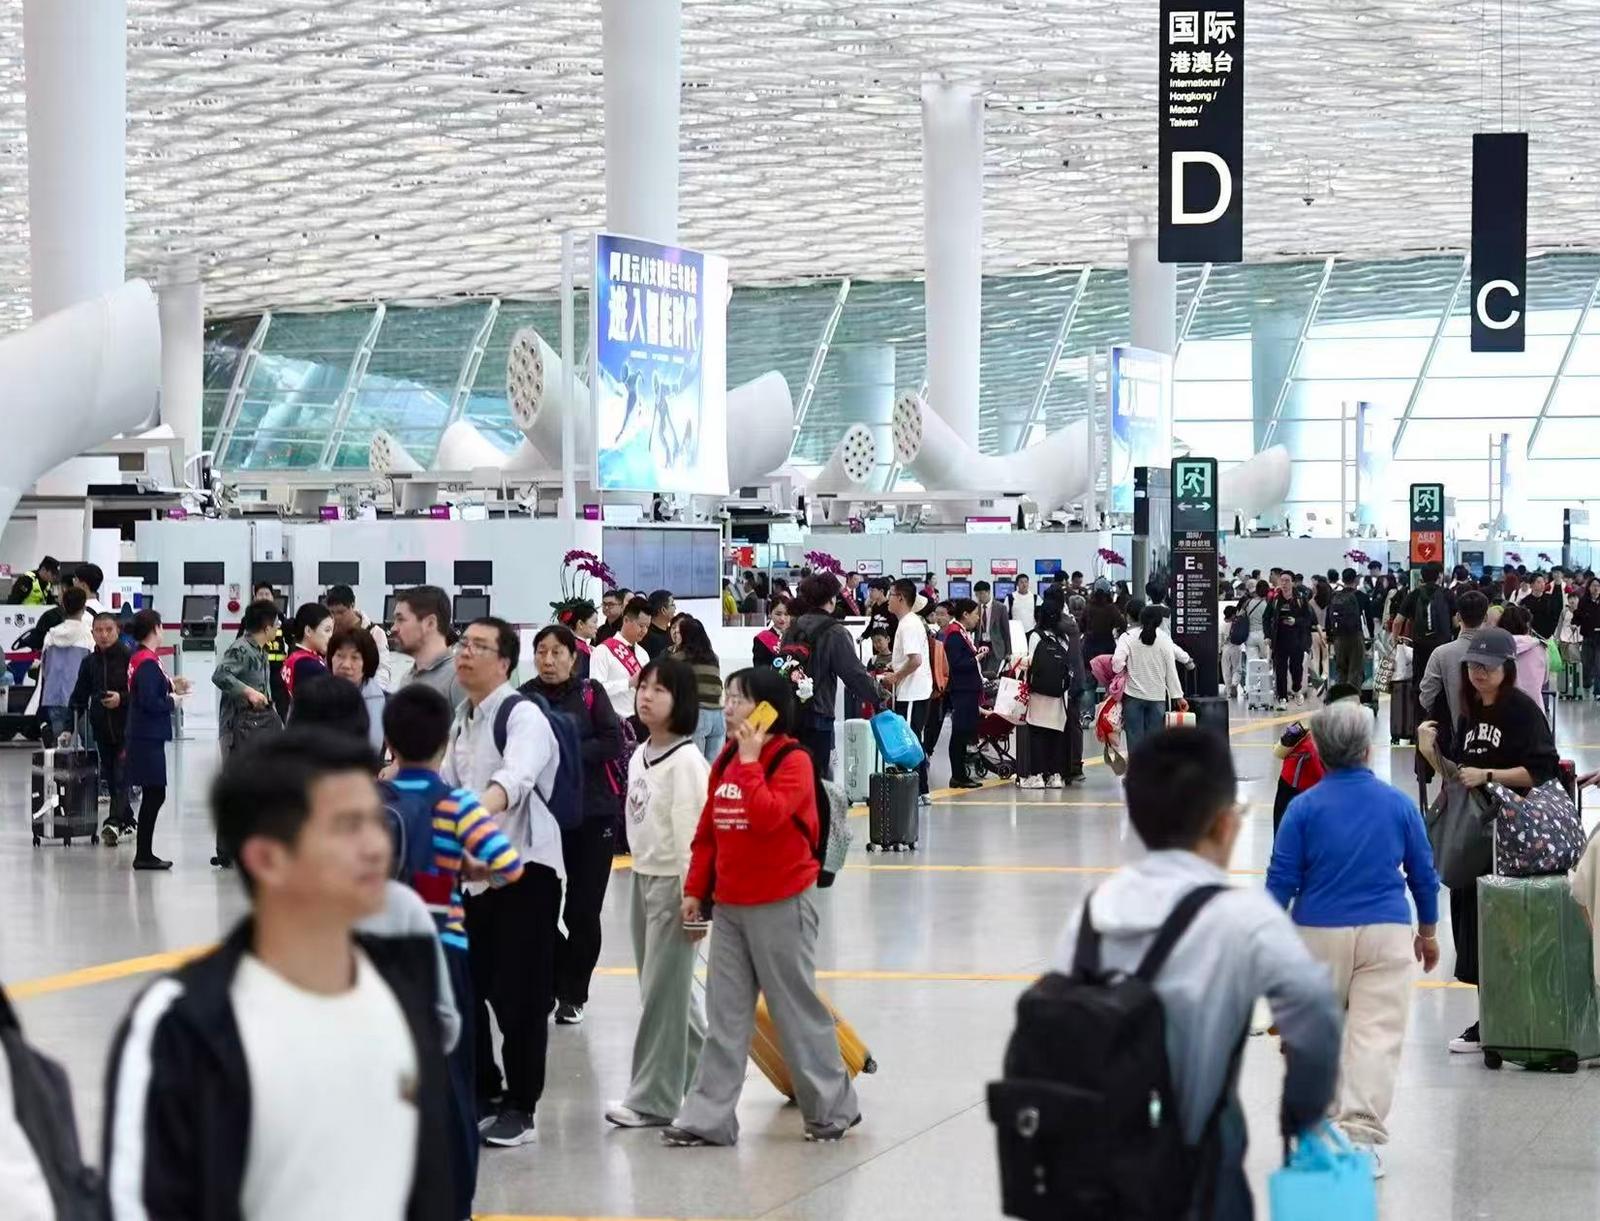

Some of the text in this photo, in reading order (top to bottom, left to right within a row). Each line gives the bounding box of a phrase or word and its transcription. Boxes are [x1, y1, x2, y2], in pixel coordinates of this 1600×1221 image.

[1168, 10, 1236, 45] 国际
[1169, 50, 1233, 74] 港澳台
[1169, 78, 1221, 88] International
[1169, 91, 1212, 103] Hongkong
[1169, 105, 1198, 114] Macao
[1169, 117, 1199, 128] Taiwan
[1171, 151, 1233, 225] D
[1476, 279, 1520, 330] C
[1185, 556, 1196, 570] E
